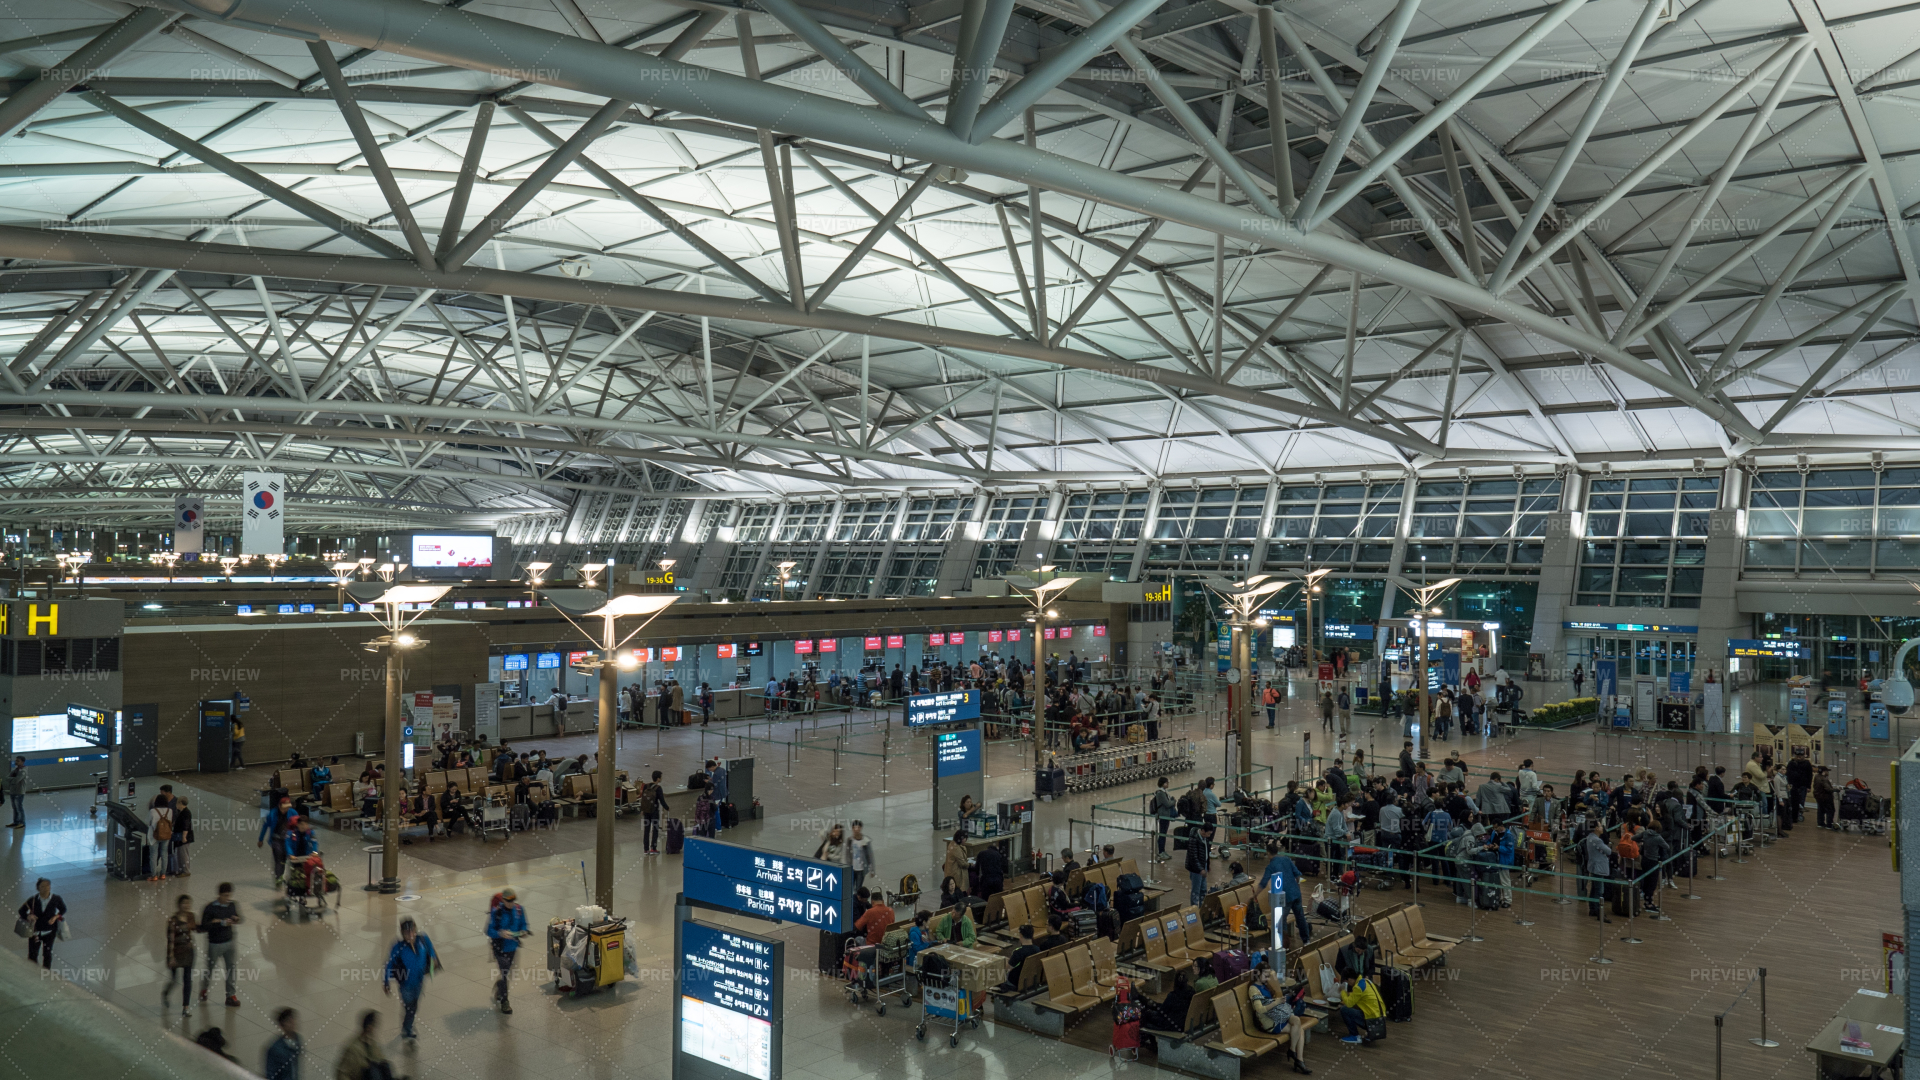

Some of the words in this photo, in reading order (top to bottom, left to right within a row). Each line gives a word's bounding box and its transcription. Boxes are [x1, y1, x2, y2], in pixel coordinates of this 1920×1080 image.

[664, 572, 673, 584] G
[1145, 592, 1162, 602] 19-36
[1162, 584, 1171, 601] H
[28, 604, 58, 636] H
[964, 693, 969, 703] 3
[756, 869, 783, 883] Arrivals
[787, 867, 803, 882] 도착
[747, 898, 774, 915] Parking
[778, 897, 803, 914] 주차장
[810, 904, 819, 919] P
